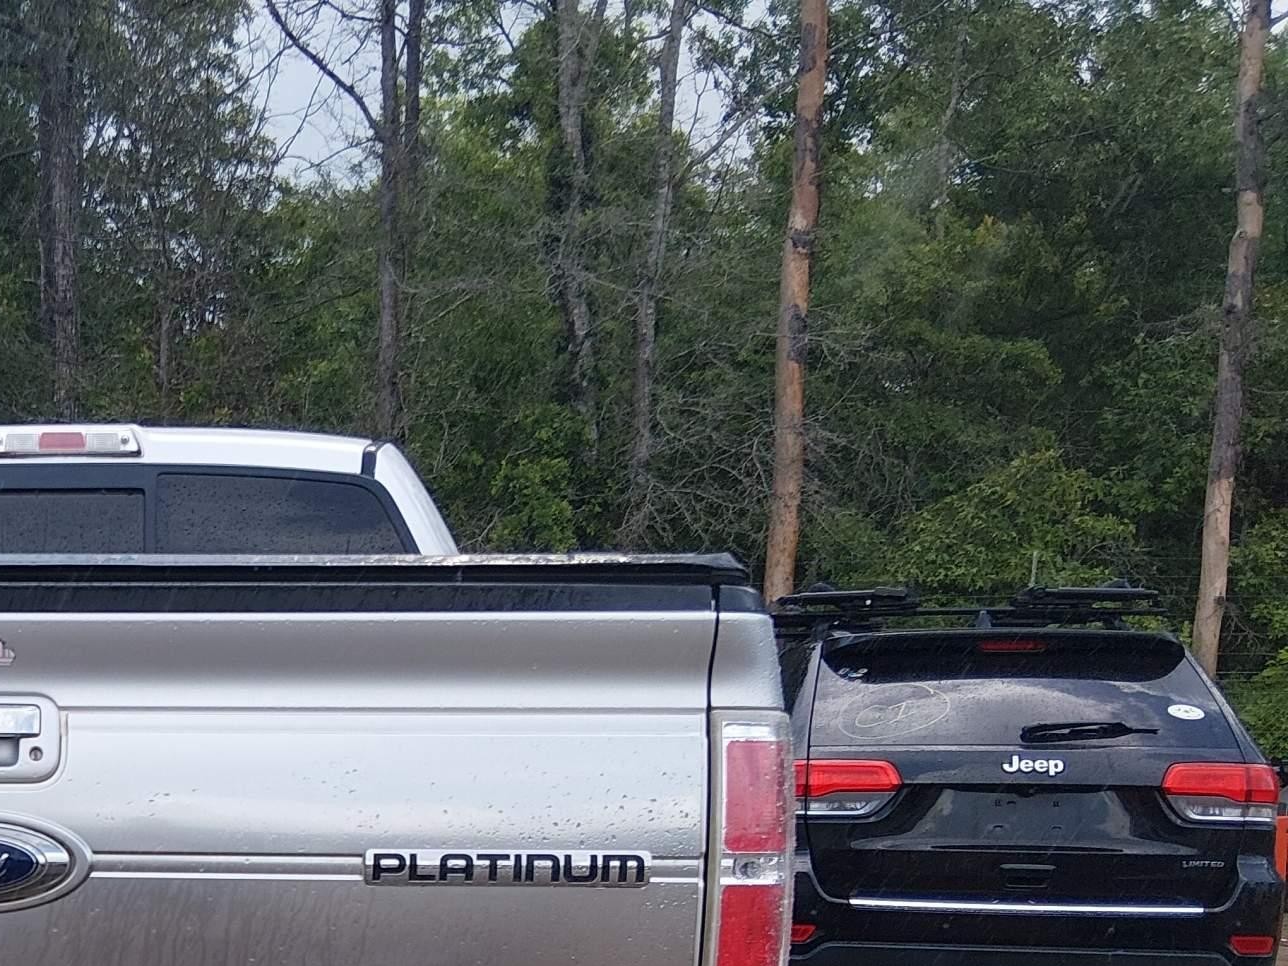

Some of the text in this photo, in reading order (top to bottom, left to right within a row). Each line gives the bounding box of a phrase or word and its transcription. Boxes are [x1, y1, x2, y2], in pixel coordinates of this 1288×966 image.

[1001, 754, 1065, 777] Jeep
[371, 852, 646, 883] PLATINUM
[1181, 860, 1225, 869] LIMITED
